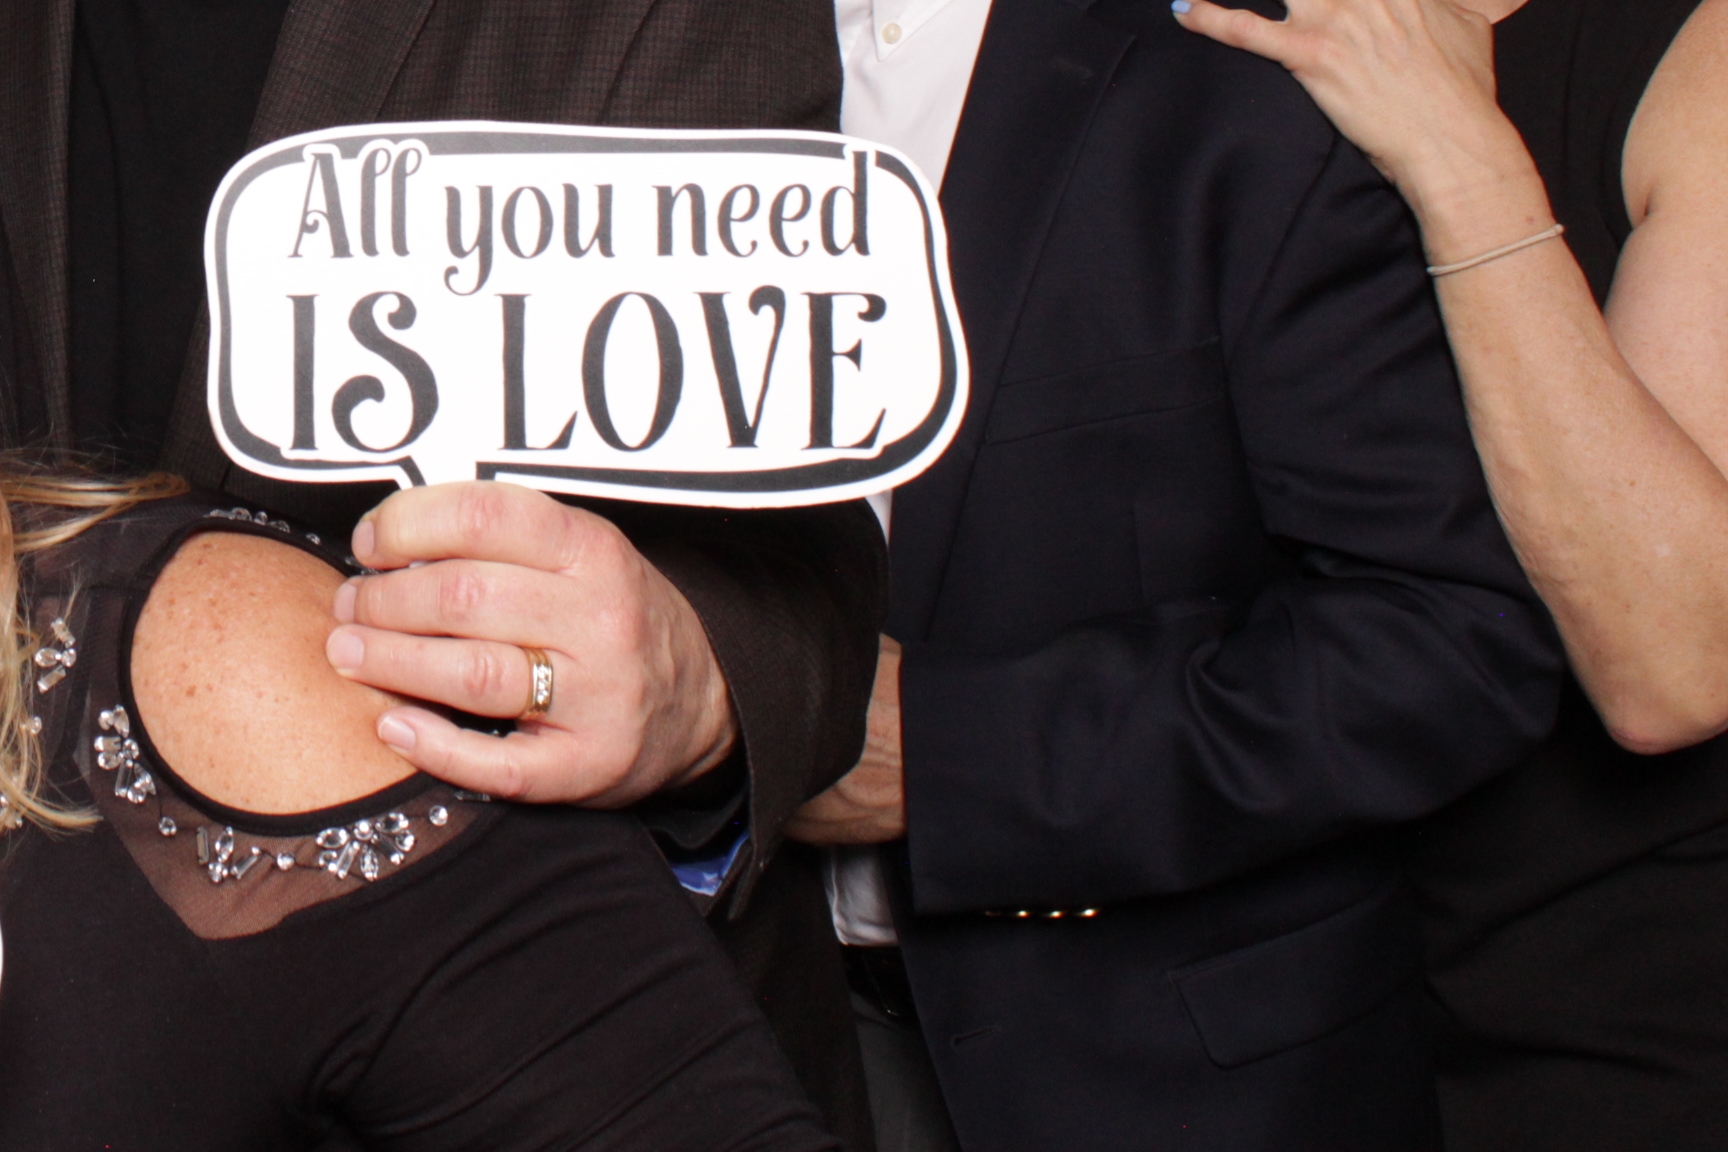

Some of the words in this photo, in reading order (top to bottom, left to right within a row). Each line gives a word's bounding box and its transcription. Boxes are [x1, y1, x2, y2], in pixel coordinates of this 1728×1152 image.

[287, 147, 423, 259] All
[443, 182, 617, 296] you
[651, 151, 872, 258] need
[285, 290, 440, 453] IS
[494, 285, 888, 453] LOVE
